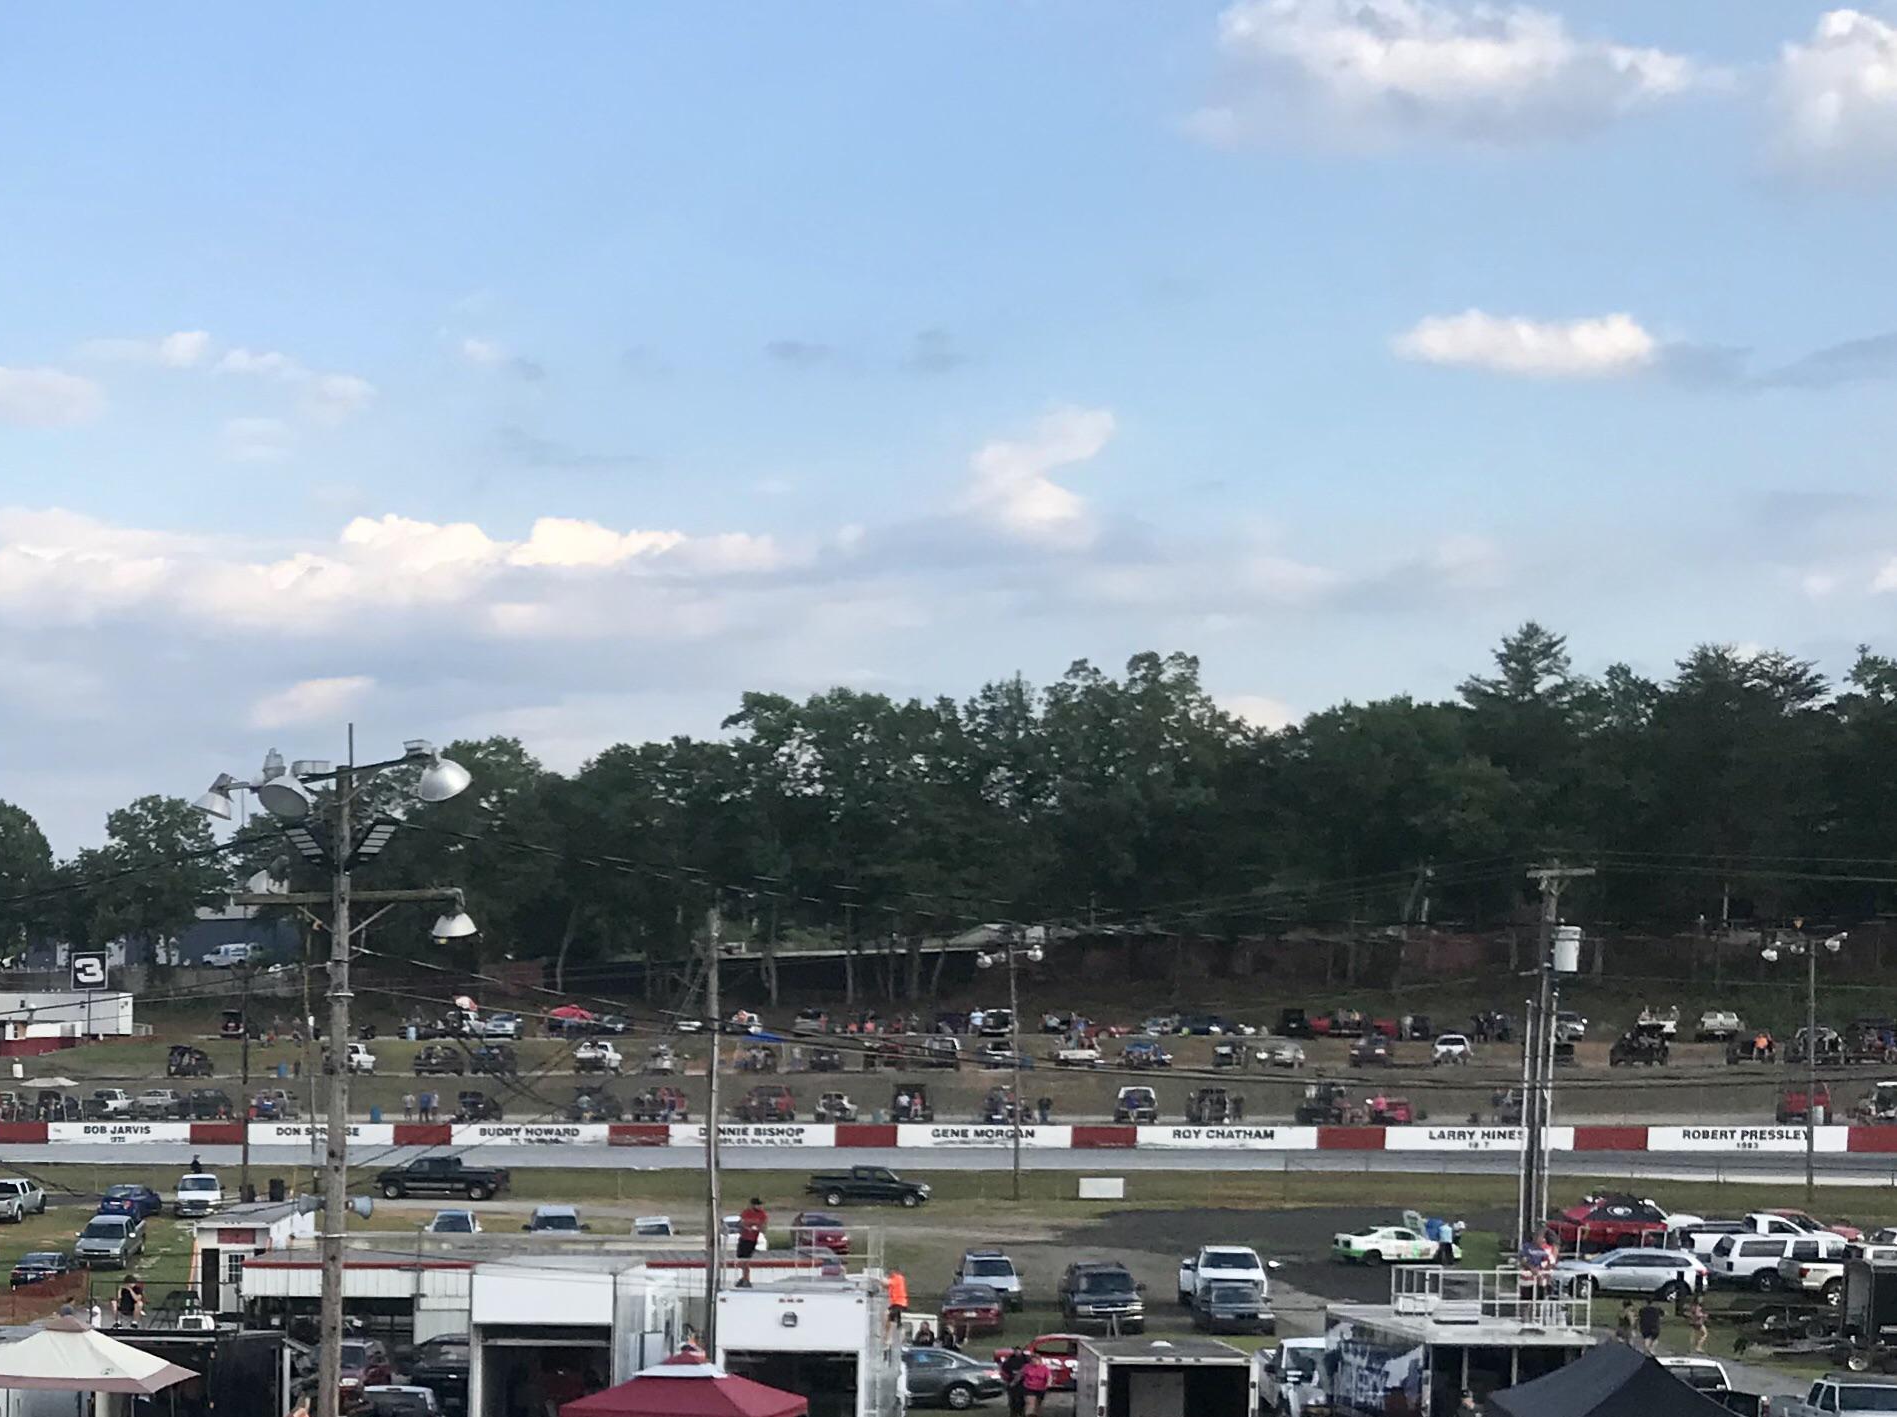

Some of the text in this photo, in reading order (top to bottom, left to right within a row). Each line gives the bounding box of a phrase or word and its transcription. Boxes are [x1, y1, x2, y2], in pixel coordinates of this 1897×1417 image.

[74, 957, 104, 983] 3
[83, 1125, 151, 1134] BOB JARVIS
[276, 1127, 359, 1136] DON SPRSE
[479, 1127, 580, 1137] BUDDY HOWARD
[699, 1127, 805, 1137] DNNIE BISHOP
[931, 1128, 1035, 1139] GENE MORGAN
[1172, 1129, 1274, 1140] ROY CHATHAM
[1682, 1129, 1808, 1140] ROBERT PRESSLEY
[1428, 1130, 1523, 1140] LARRY HINES
